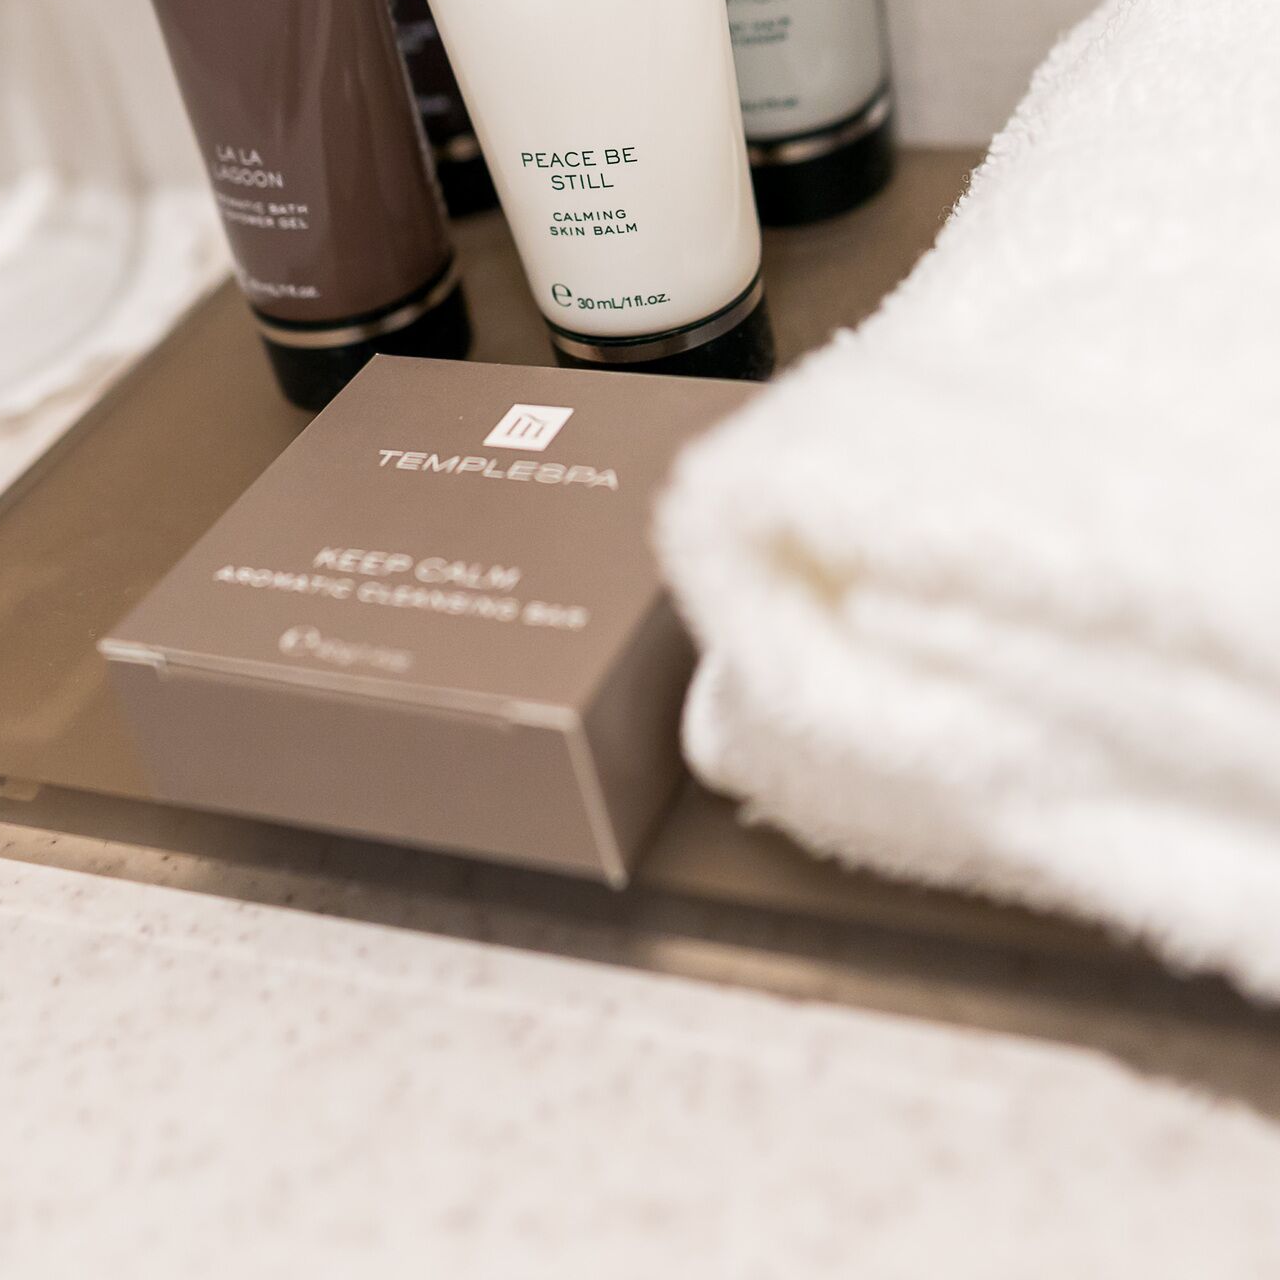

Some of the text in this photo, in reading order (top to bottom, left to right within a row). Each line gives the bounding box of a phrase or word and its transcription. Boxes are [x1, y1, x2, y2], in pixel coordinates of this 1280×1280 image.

[216, 144, 263, 166] LA LA
[521, 146, 639, 169] PEACE BE
[550, 172, 615, 191] STILL
[552, 208, 627, 223] CALMING
[549, 222, 639, 237] SKIN BALM
[378, 448, 620, 491] TEMPLESPA
[313, 546, 521, 592] KEEP CALM
